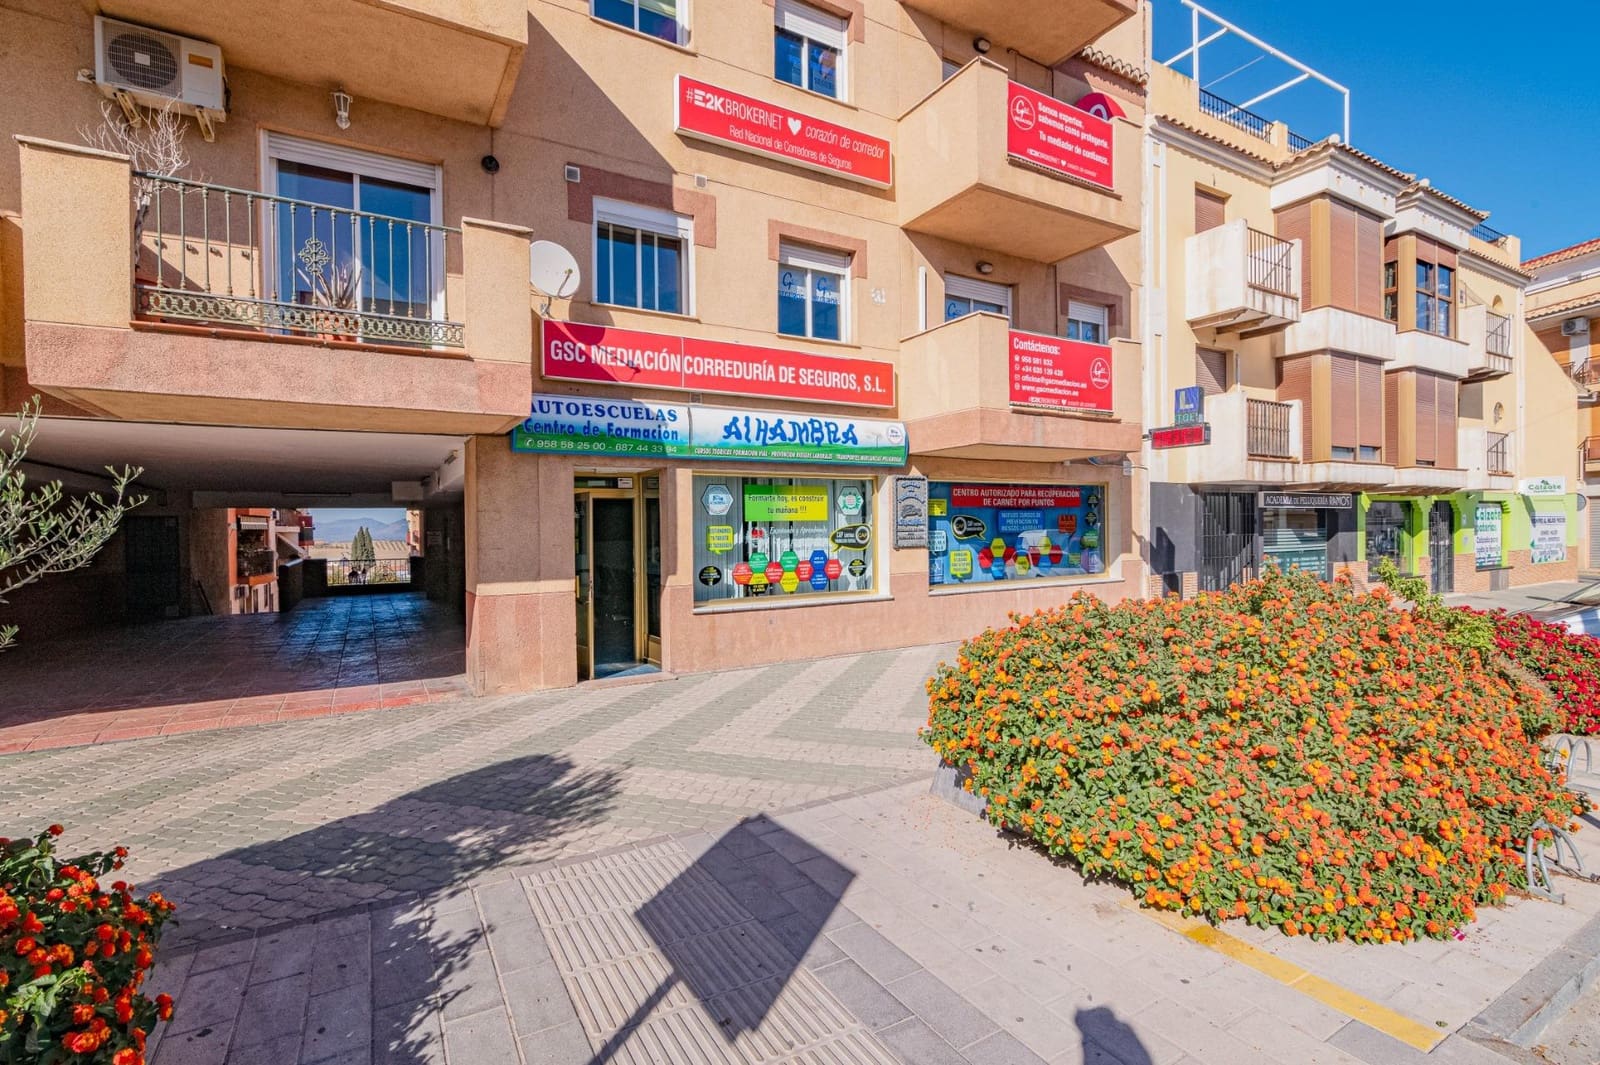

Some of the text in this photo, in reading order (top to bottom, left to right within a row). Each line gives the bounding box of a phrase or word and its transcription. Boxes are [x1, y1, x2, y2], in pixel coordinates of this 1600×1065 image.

[729, 125, 852, 170] Red Nacional de Corredores de Seguros
[805, 126, 838, 145] corazón
[840, 135, 850, 149] de
[852, 141, 885, 159] corredor
[1047, 135, 1074, 152] mediador
[1014, 338, 1060, 355] Contáctenos:
[550, 340, 886, 393] GSC MEDIACIÓN CORREDURÍA DE SEGUROS, S.L.
[1180, 391, 1194, 409] L
[524, 418, 678, 441] Centro de Formación
[536, 439, 557, 448] 958
[560, 440, 574, 449] 58
[577, 441, 590, 450] 25
[592, 442, 606, 451] 00
[636, 444, 648, 452] 44
[651, 445, 663, 453] 33
[695, 447, 711, 455] CURSOS
[748, 494, 775, 502] Formarte
[798, 494, 824, 502] construir
[953, 488, 1080, 498] CENTRO AUTORIZADO PARA RECUPERACIÓN
[1266, 495, 1292, 505] ACADEMIA
[1329, 496, 1350, 506] RAMOS
[775, 505, 798, 514] mañana
[993, 498, 1017, 506] CARNET
